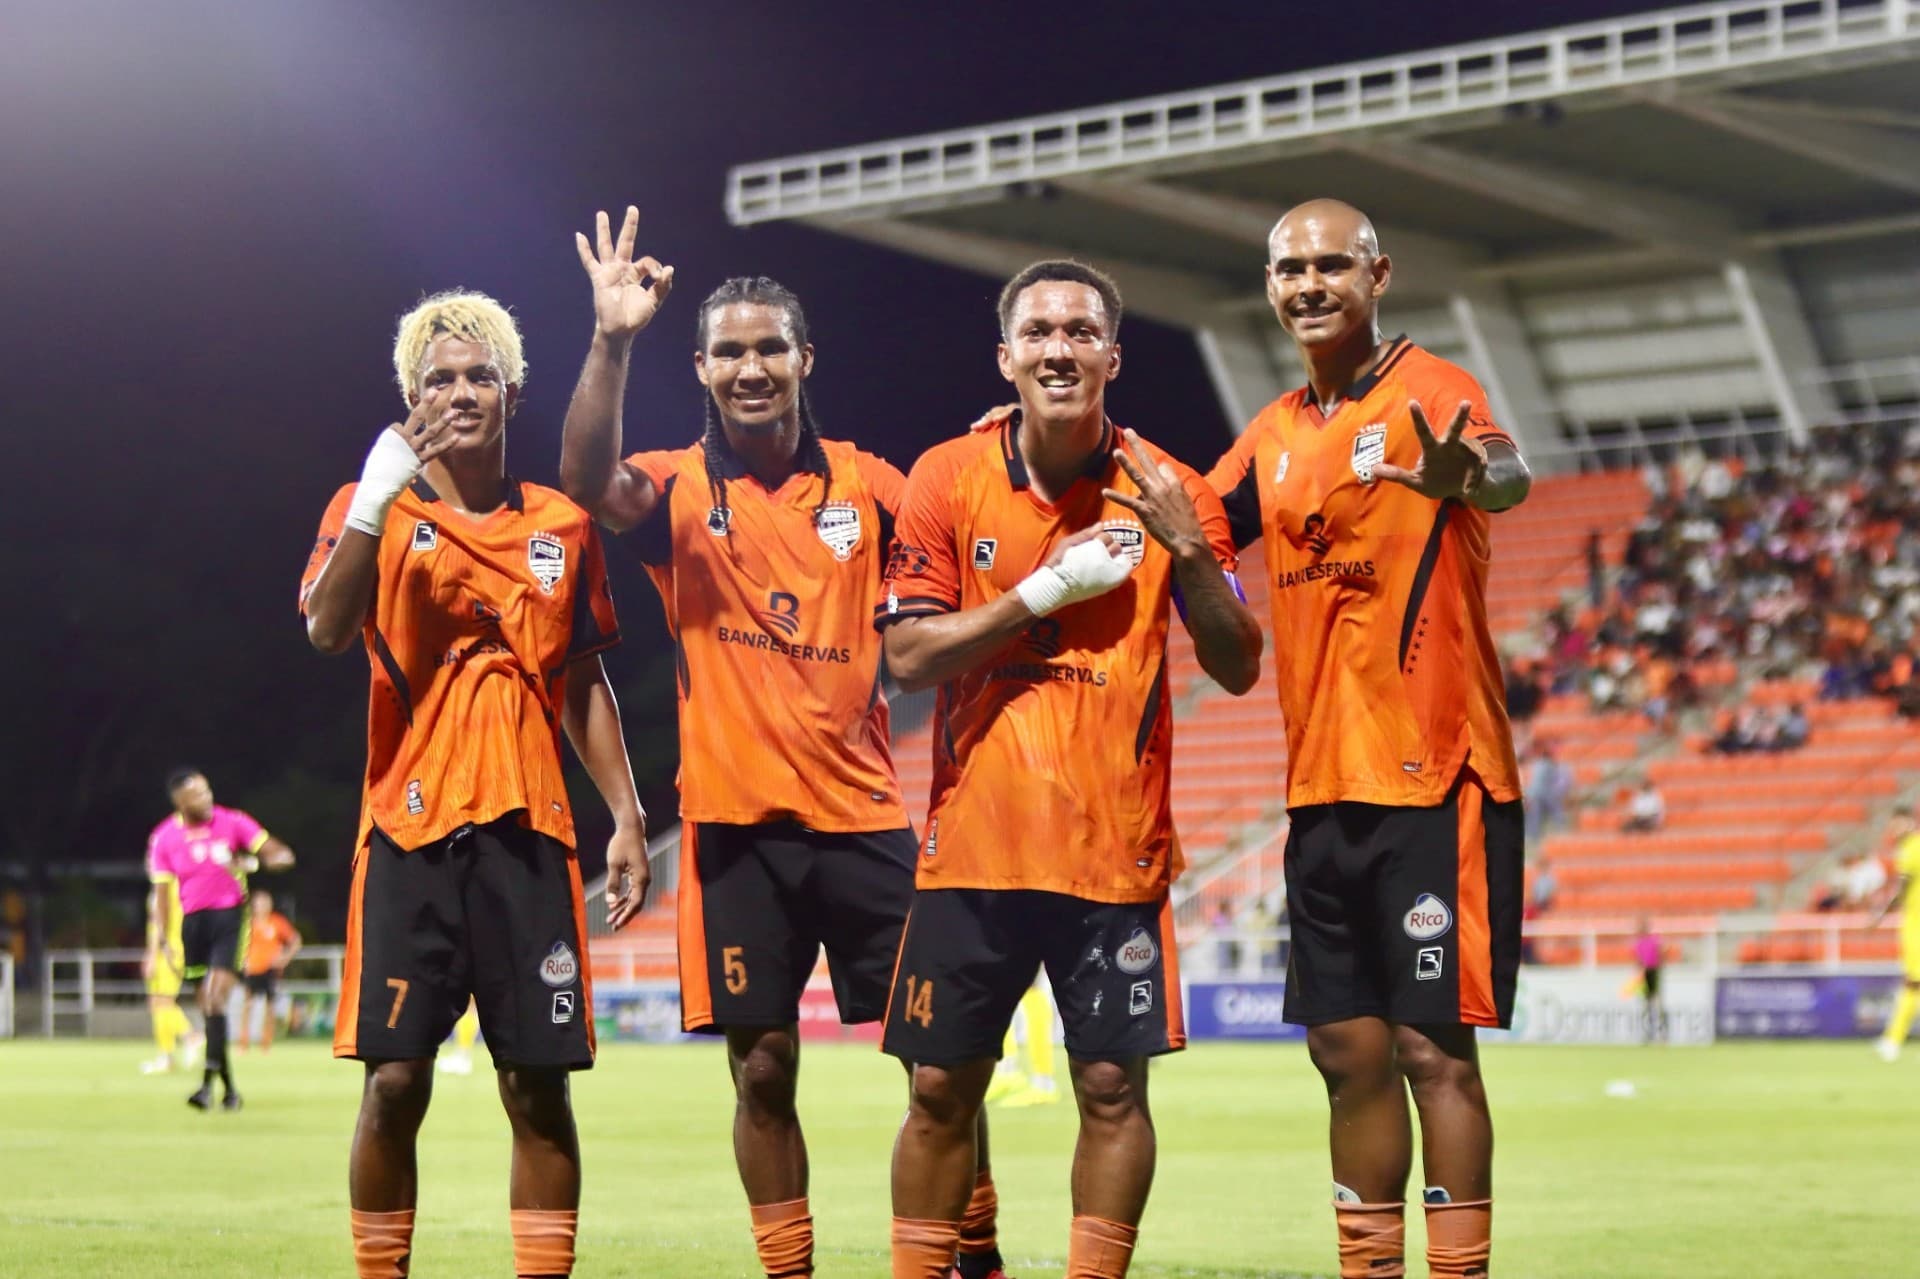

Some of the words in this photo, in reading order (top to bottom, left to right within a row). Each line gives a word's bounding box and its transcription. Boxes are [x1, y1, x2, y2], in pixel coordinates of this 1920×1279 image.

[1279, 561, 1375, 588] BANRESERVAS
[718, 627, 850, 663] BANRESERVAS
[994, 662, 1108, 686] ANRESERVAS
[1410, 913, 1443, 928] Rica
[546, 960, 573, 975] Rica
[1124, 946, 1151, 962] Rica
[723, 947, 748, 995] 5
[387, 978, 409, 1029] 7
[904, 975, 934, 1029] 14
